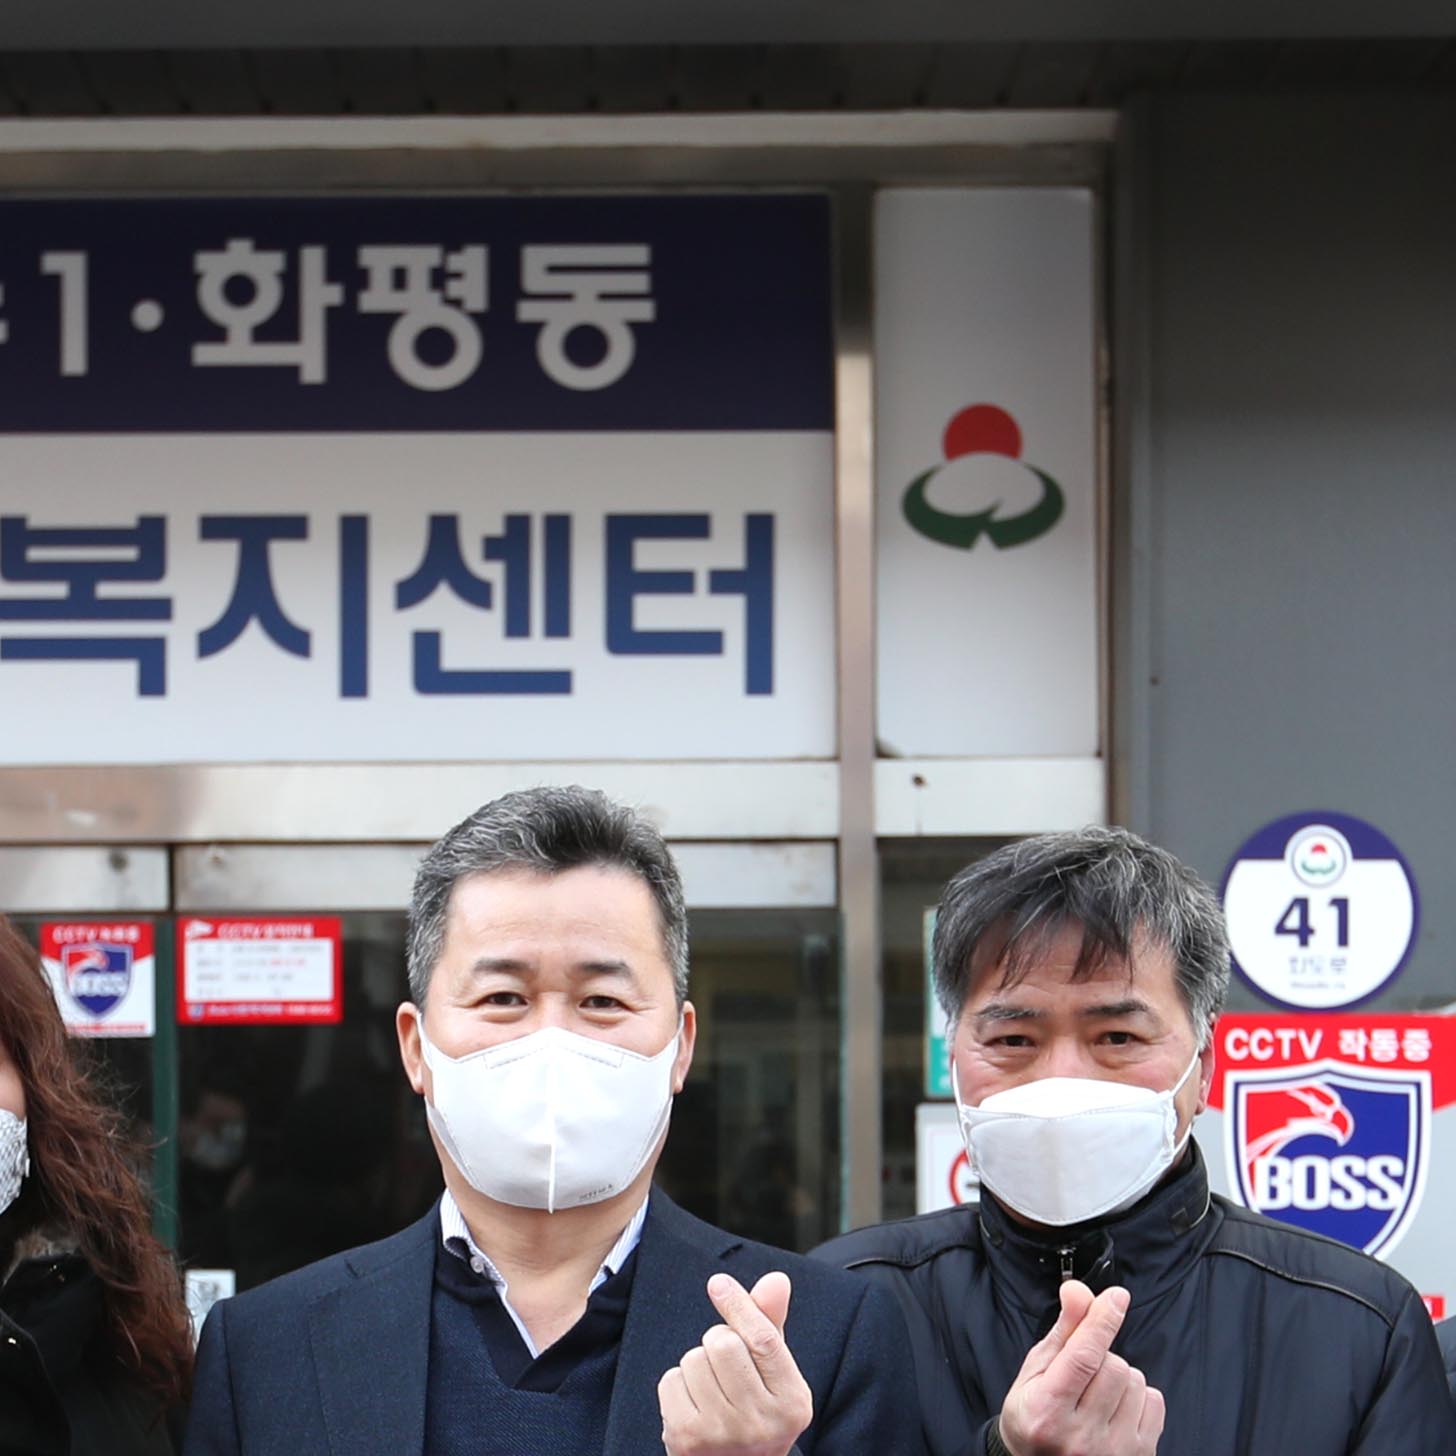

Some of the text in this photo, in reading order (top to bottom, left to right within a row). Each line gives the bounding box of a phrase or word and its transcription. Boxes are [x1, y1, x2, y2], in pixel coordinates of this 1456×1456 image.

[1275, 897, 1349, 947] 41
[1224, 1027, 1432, 1063] CCTV 작동중
[1253, 1155, 1405, 1211] BOSS
